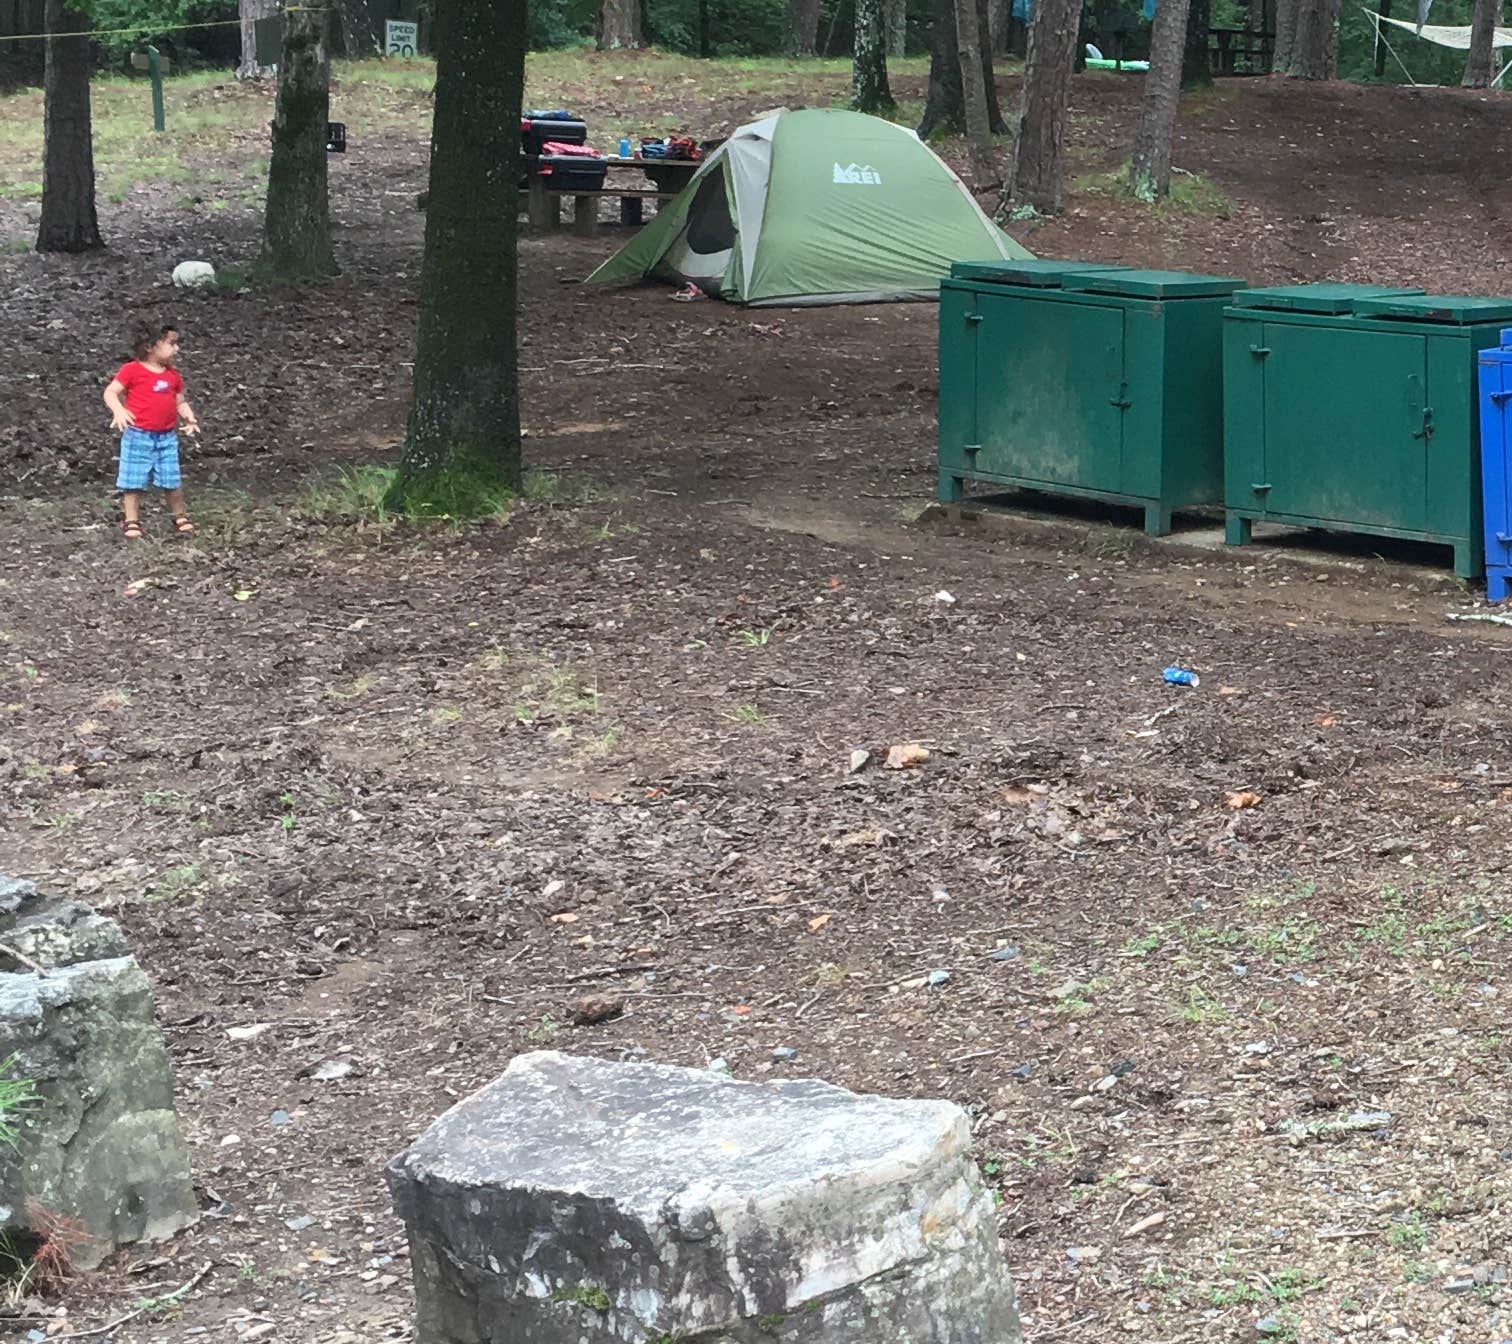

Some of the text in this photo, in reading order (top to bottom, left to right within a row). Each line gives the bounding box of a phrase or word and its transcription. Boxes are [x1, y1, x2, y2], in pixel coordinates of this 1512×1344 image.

[389, 24, 415, 34] SPEED
[391, 34, 411, 43] LIMIT
[389, 43, 414, 57] 20
